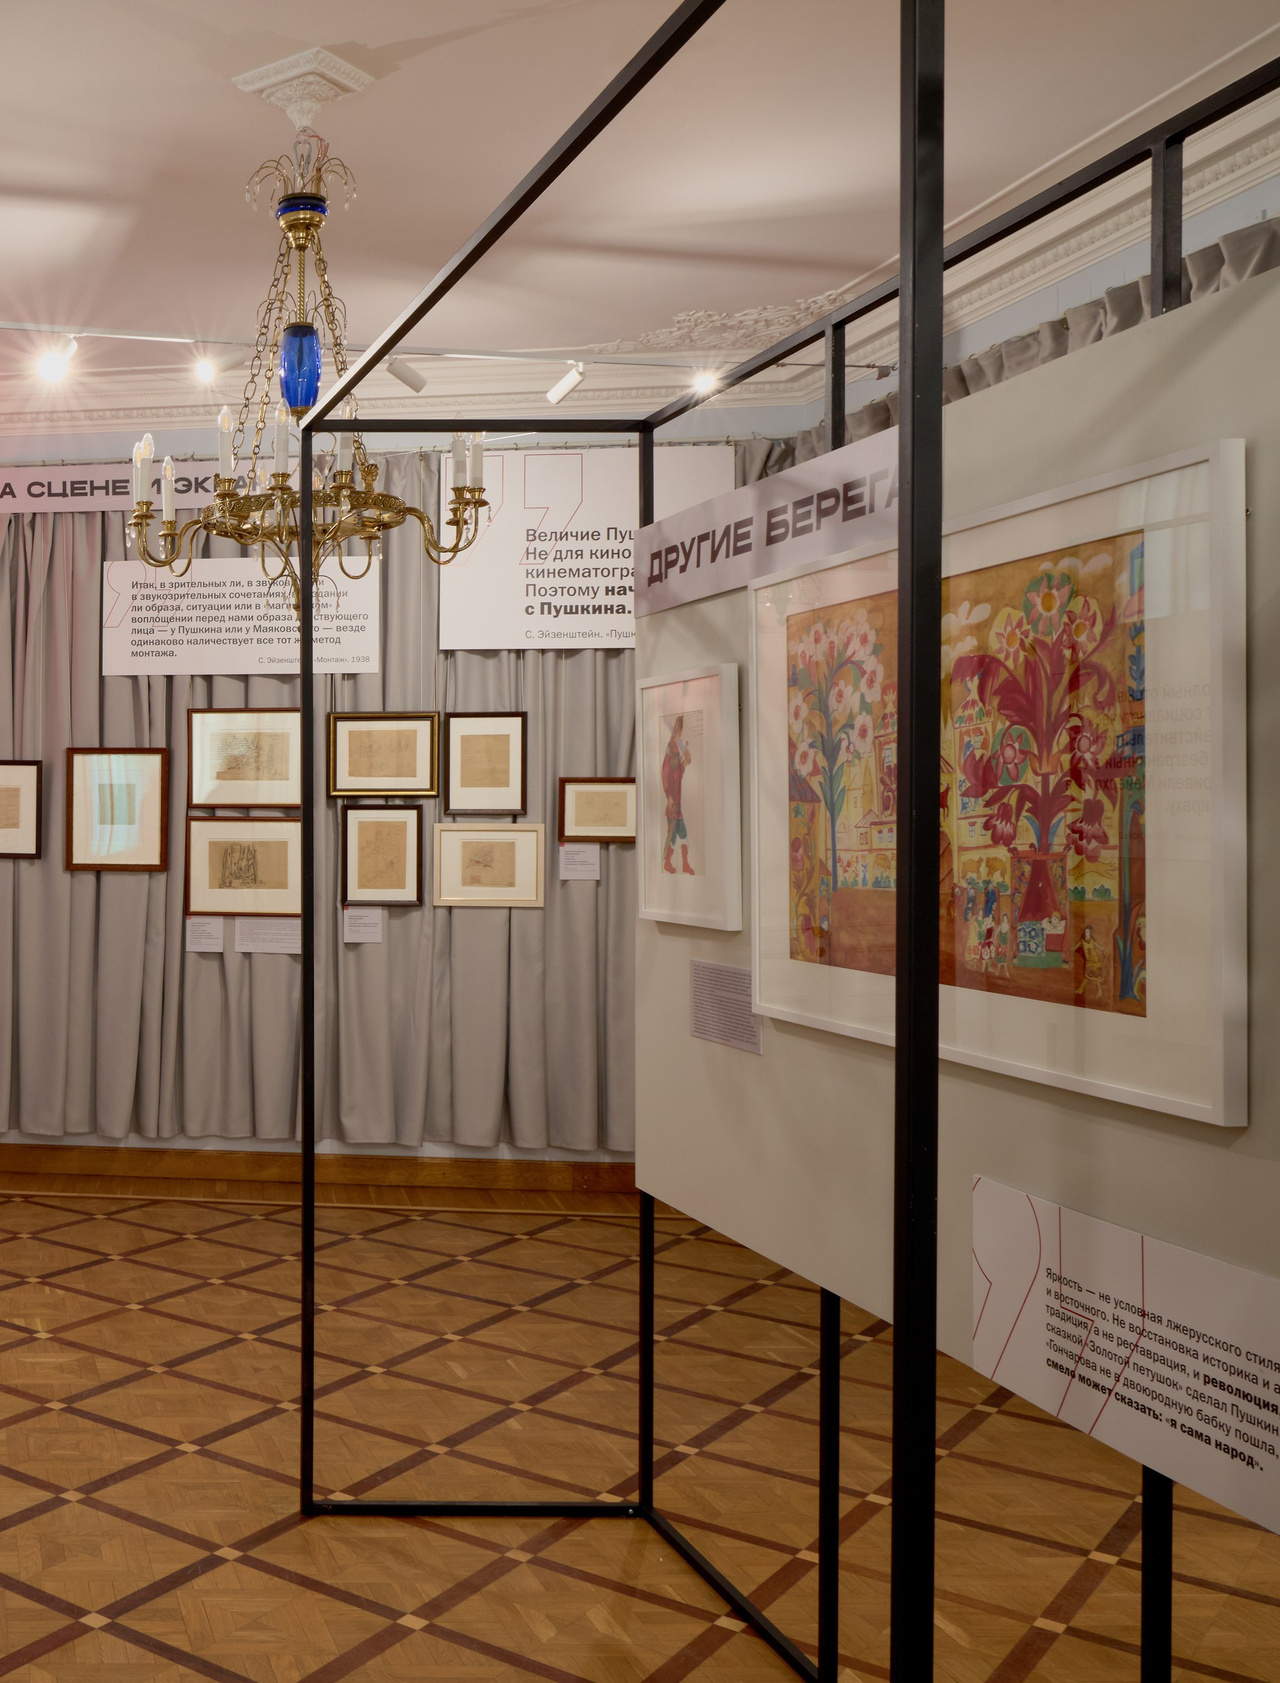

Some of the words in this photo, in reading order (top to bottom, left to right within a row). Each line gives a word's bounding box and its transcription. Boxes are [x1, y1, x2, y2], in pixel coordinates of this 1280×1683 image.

[27, 479, 130, 498] СЦЕНЕ
[526, 529, 601, 542] Величие
[526, 547, 548, 560] Не
[553, 549, 583, 562] для
[648, 517, 753, 587] ДРУГИЕ
[132, 581, 157, 590] Итак,
[168, 581, 227, 591] зрительных
[526, 584, 600, 599] Поэтому
[140, 592, 226, 604] звукозрительных
[229, 591, 291, 600] сочетаниях,
[145, 603, 184, 614] образа,
[186, 603, 232, 613] ситуации
[525, 606, 535, 615] с
[540, 602, 632, 618] Пушкина.
[132, 615, 193, 624] воплощении
[196, 615, 225, 624] перед
[256, 612, 293, 623] образа
[131, 627, 155, 636] лица
[179, 625, 223, 636] Пушкина
[525, 630, 534, 638] С.
[538, 630, 603, 638] Эйзенштейн.
[131, 638, 184, 647] одинаково
[187, 638, 253, 647] наличествует
[277, 637, 291, 645] тот
[131, 649, 177, 658] монтажа.
[1046, 1268, 1083, 1293] Яркость
[1099, 1292, 1111, 1304] не
[1114, 1297, 1162, 1325] условная
[1166, 1319, 1242, 1357] лжерусского
[1246, 1351, 1280, 1373] стиля
[1054, 1292, 1109, 1323] восточного.
[1113, 1313, 1126, 1329] Не
[1129, 1322, 1198, 1360] восстановка
[1203, 1353, 1258, 1385] историка
[1263, 1378, 1270, 1390] и
[1102, 1329, 1114, 1342] не
[1117, 1337, 1190, 1378] реставрация,
[1046, 1322, 1083, 1346] сказкой
[1086, 1340, 1130, 1369] «Золотой
[1132, 1362, 1182, 1391] петушок»
[1186, 1386, 1228, 1411] сделал
[1231, 1404, 1280, 1437] Пушкин
[1046, 1339, 1097, 1372] «Гончарова
[1100, 1366, 1112, 1379] не
[1123, 1377, 1193, 1416] двоюродную
[1197, 1409, 1232, 1437] бабку
[1235, 1428, 1280, 1458] пошла,
[1046, 1358, 1076, 1379] смело
[1078, 1374, 1113, 1397] может
[1115, 1391, 1162, 1422] сказать:
[1165, 1417, 1177, 1429] «я
[1181, 1423, 1211, 1446] сама
[1215, 1439, 1264, 1471] народ».
